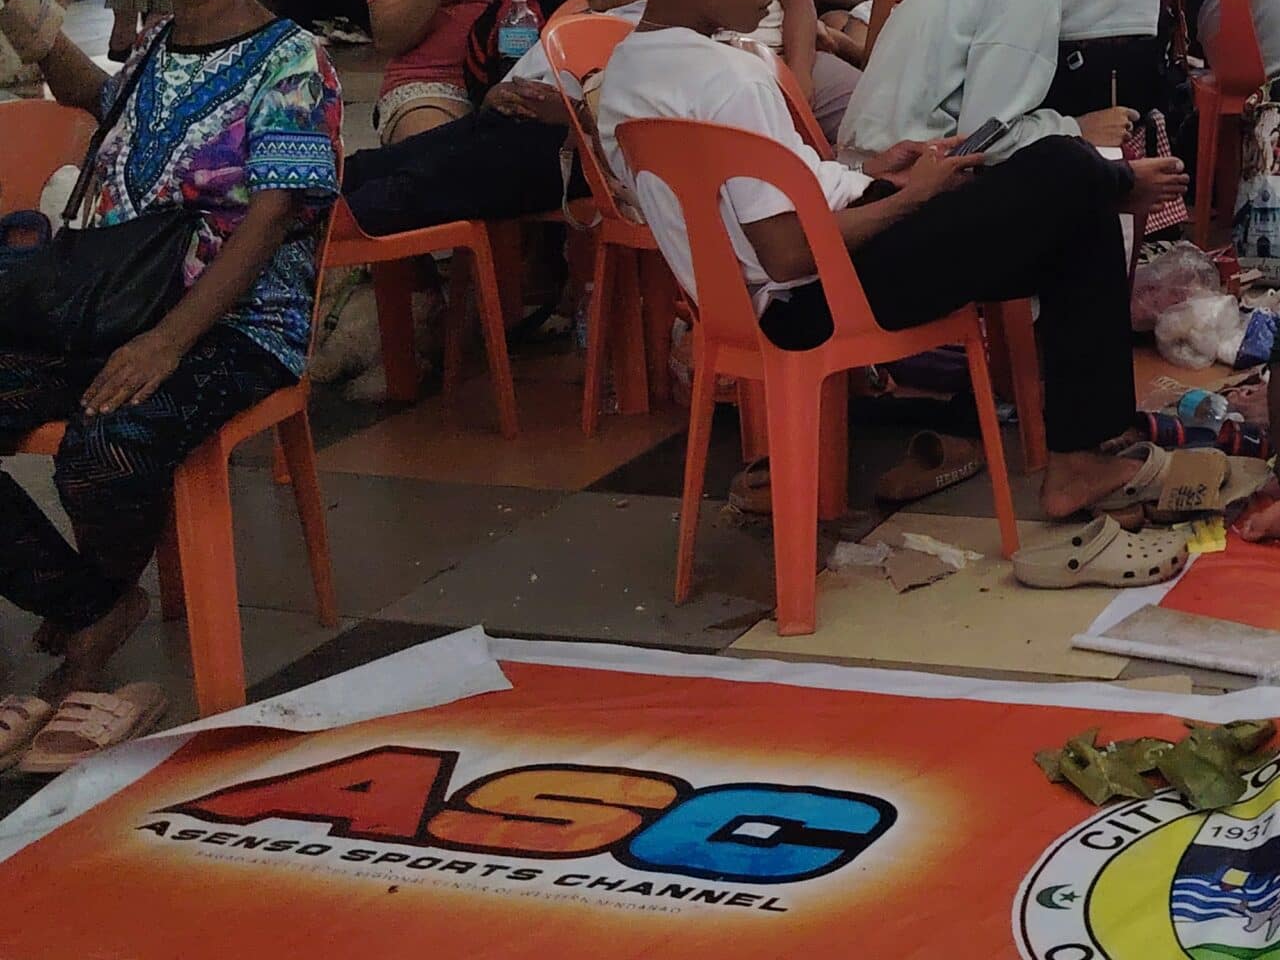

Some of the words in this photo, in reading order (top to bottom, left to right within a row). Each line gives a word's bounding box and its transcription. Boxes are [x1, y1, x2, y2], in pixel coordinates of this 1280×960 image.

[150, 744, 900, 883] ASC
[1080, 786, 1196, 852] CITY
[134, 820, 332, 856] ASENSO
[340, 848, 544, 881] SPORTS
[552, 873, 789, 913] CHANNEL
